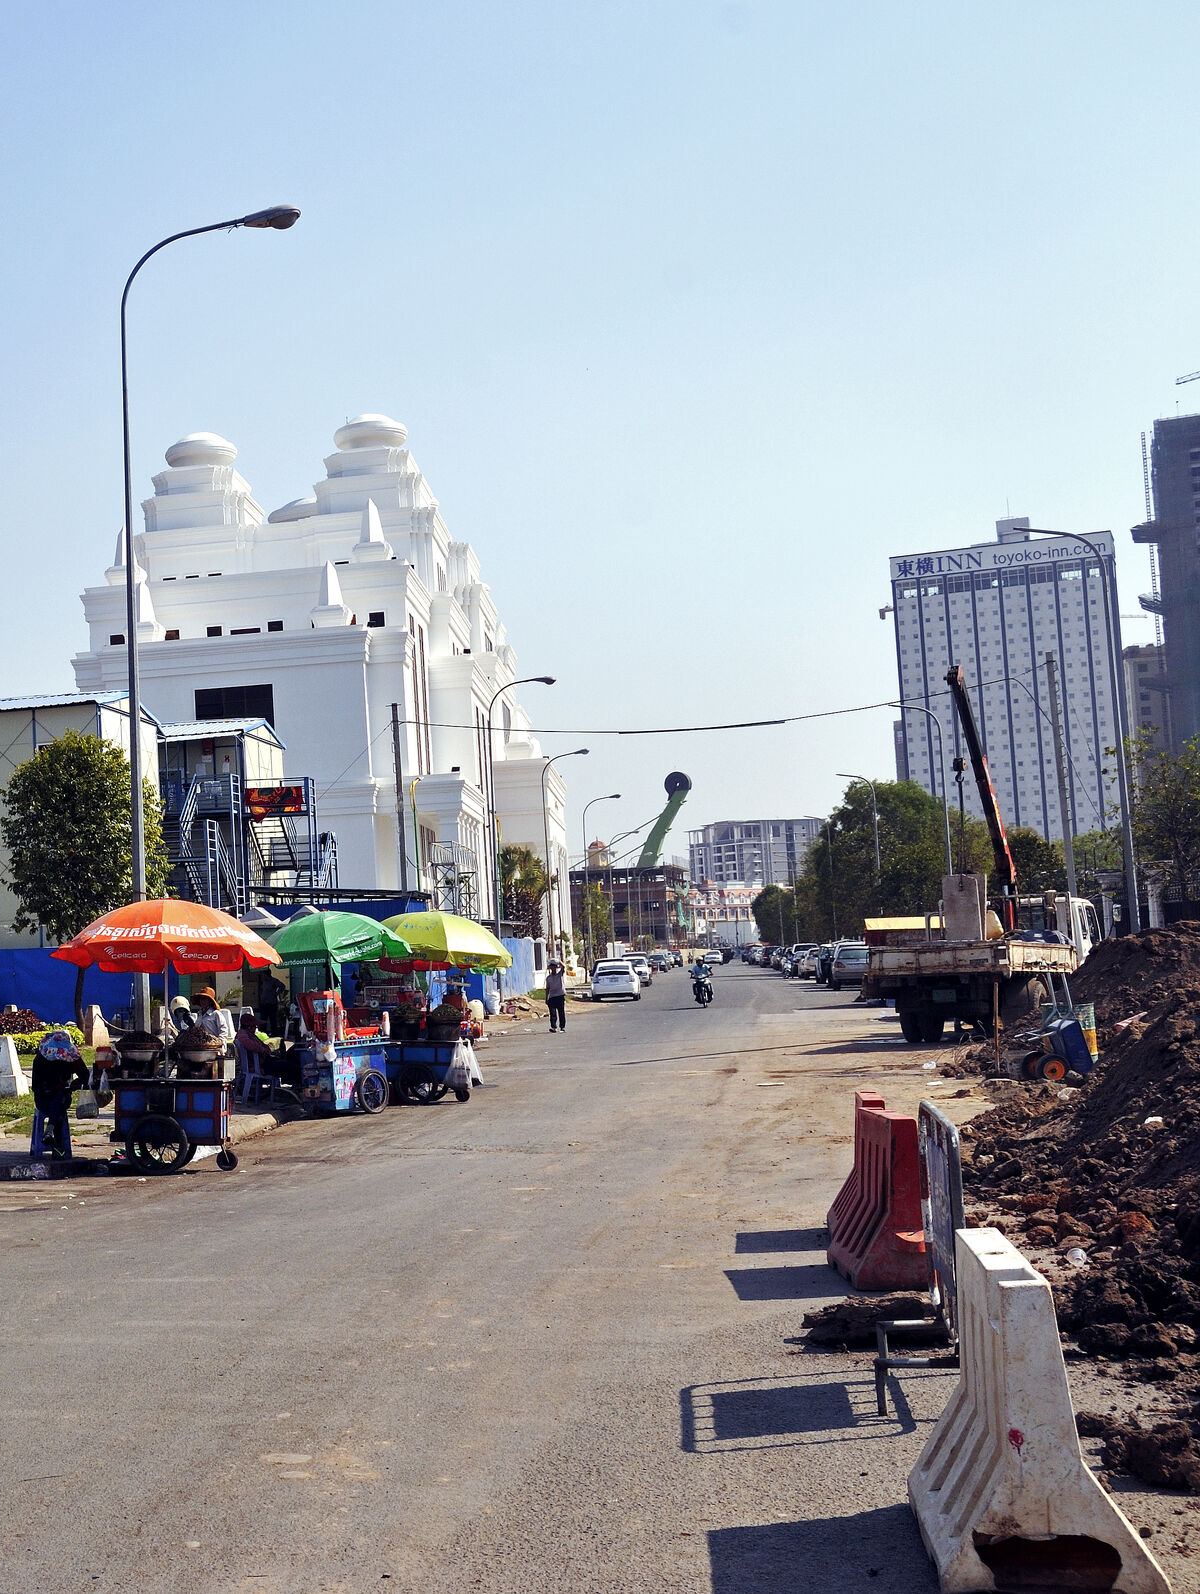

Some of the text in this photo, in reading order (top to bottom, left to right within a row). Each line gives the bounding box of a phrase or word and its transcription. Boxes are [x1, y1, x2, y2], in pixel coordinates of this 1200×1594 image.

[896, 542, 1106, 577] 東横INN toyoko-inn.com
[111, 952, 147, 960] cellcard
